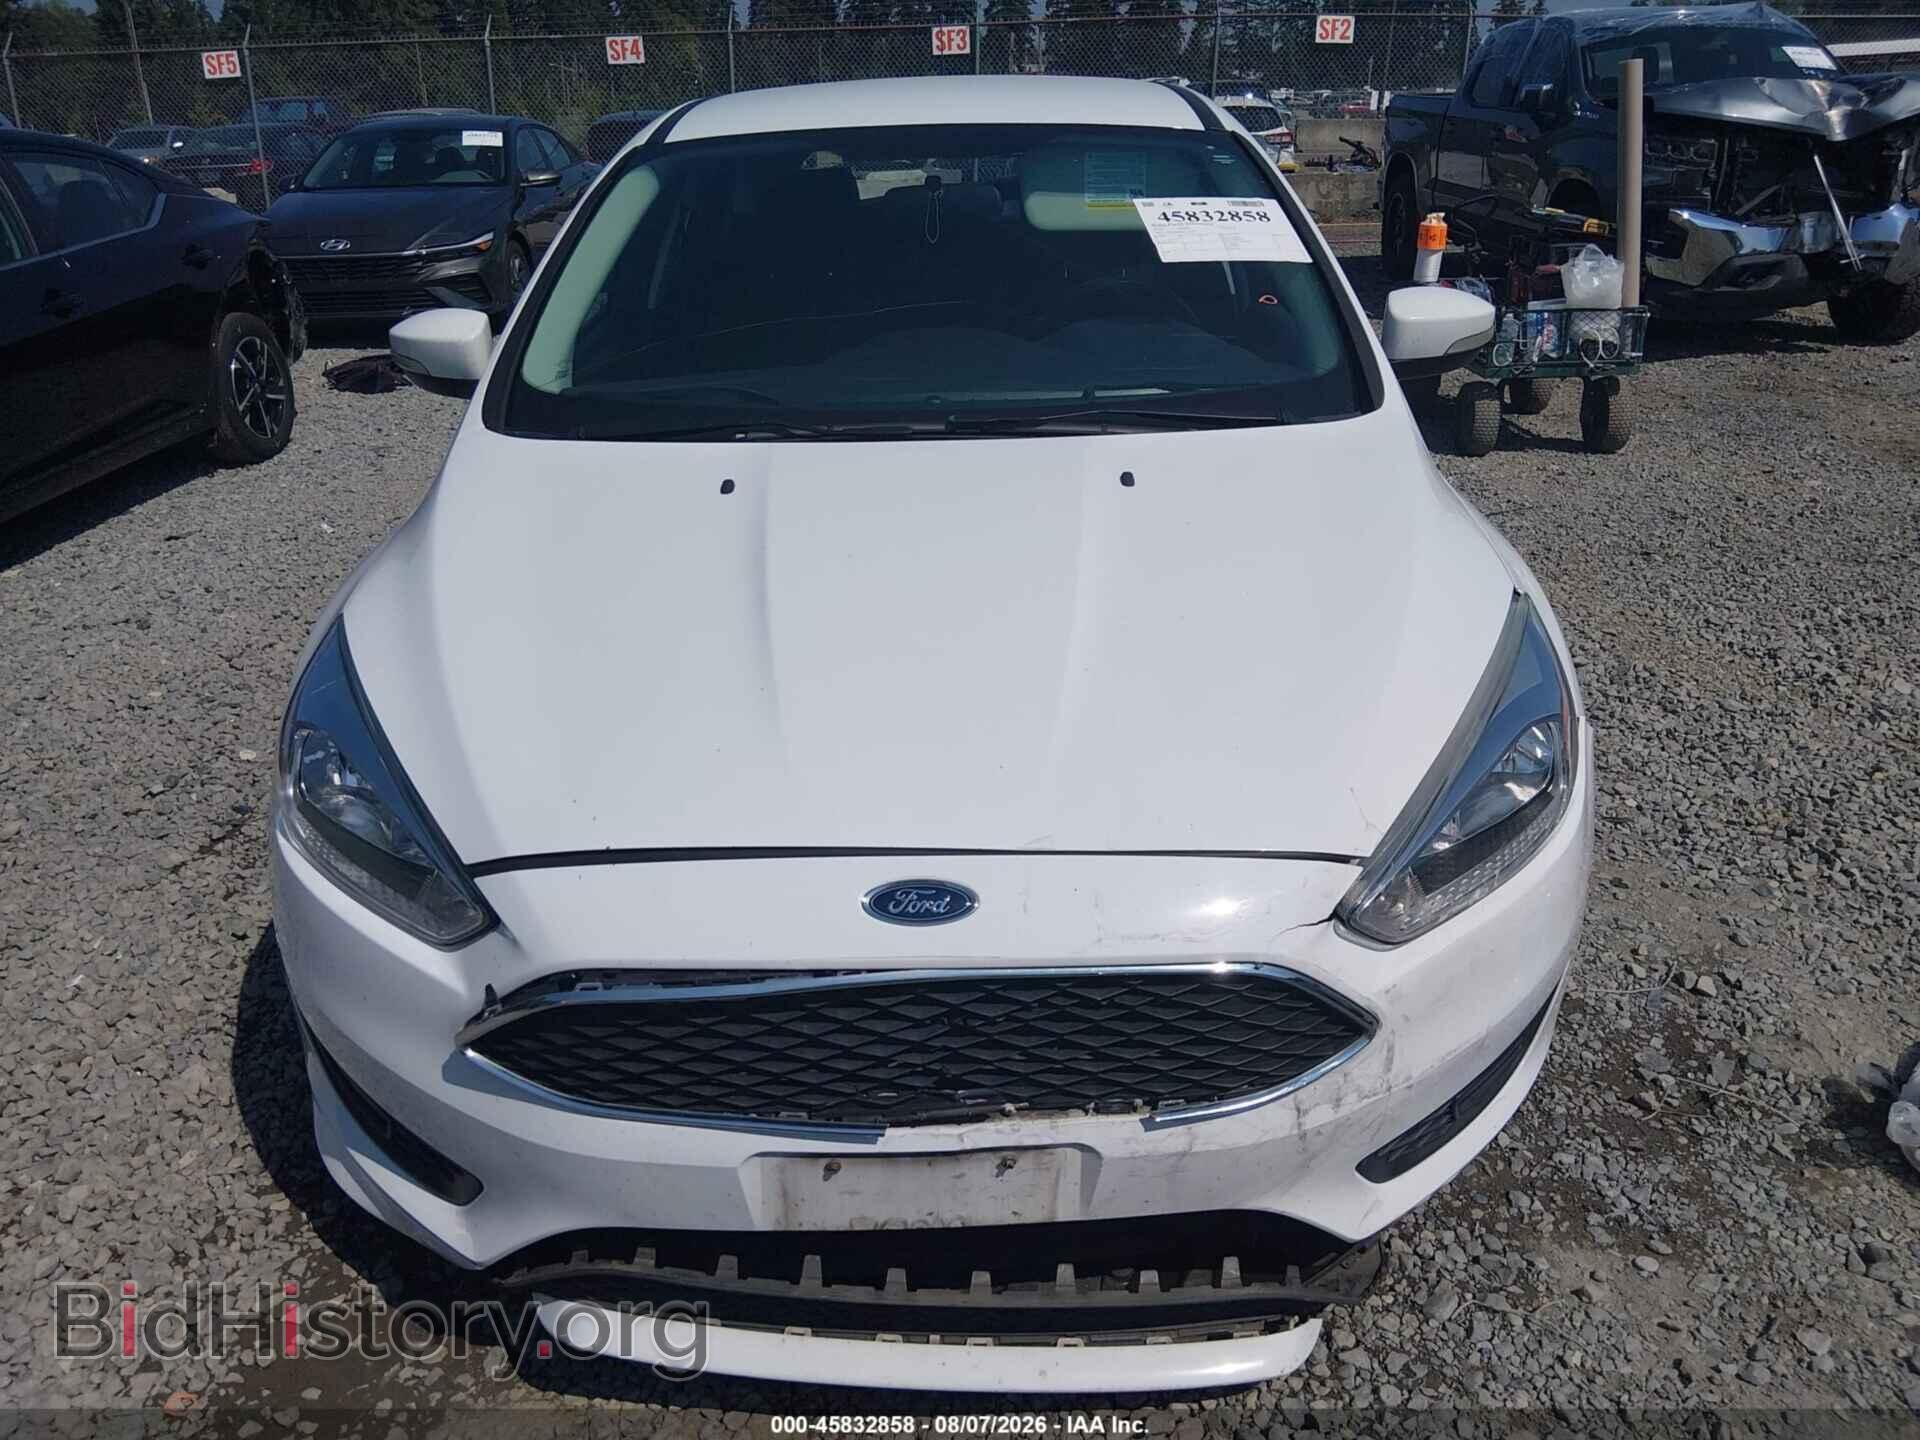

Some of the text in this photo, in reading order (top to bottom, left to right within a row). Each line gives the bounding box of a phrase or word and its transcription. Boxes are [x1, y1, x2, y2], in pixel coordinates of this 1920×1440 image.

[935, 29, 967, 51] SF3
[1319, 18, 1351, 40] SF2
[608, 39, 640, 61] SF4
[205, 53, 237, 75] SF5
[1157, 210, 1271, 223] 45832858
[888, 889, 951, 913] Ford
